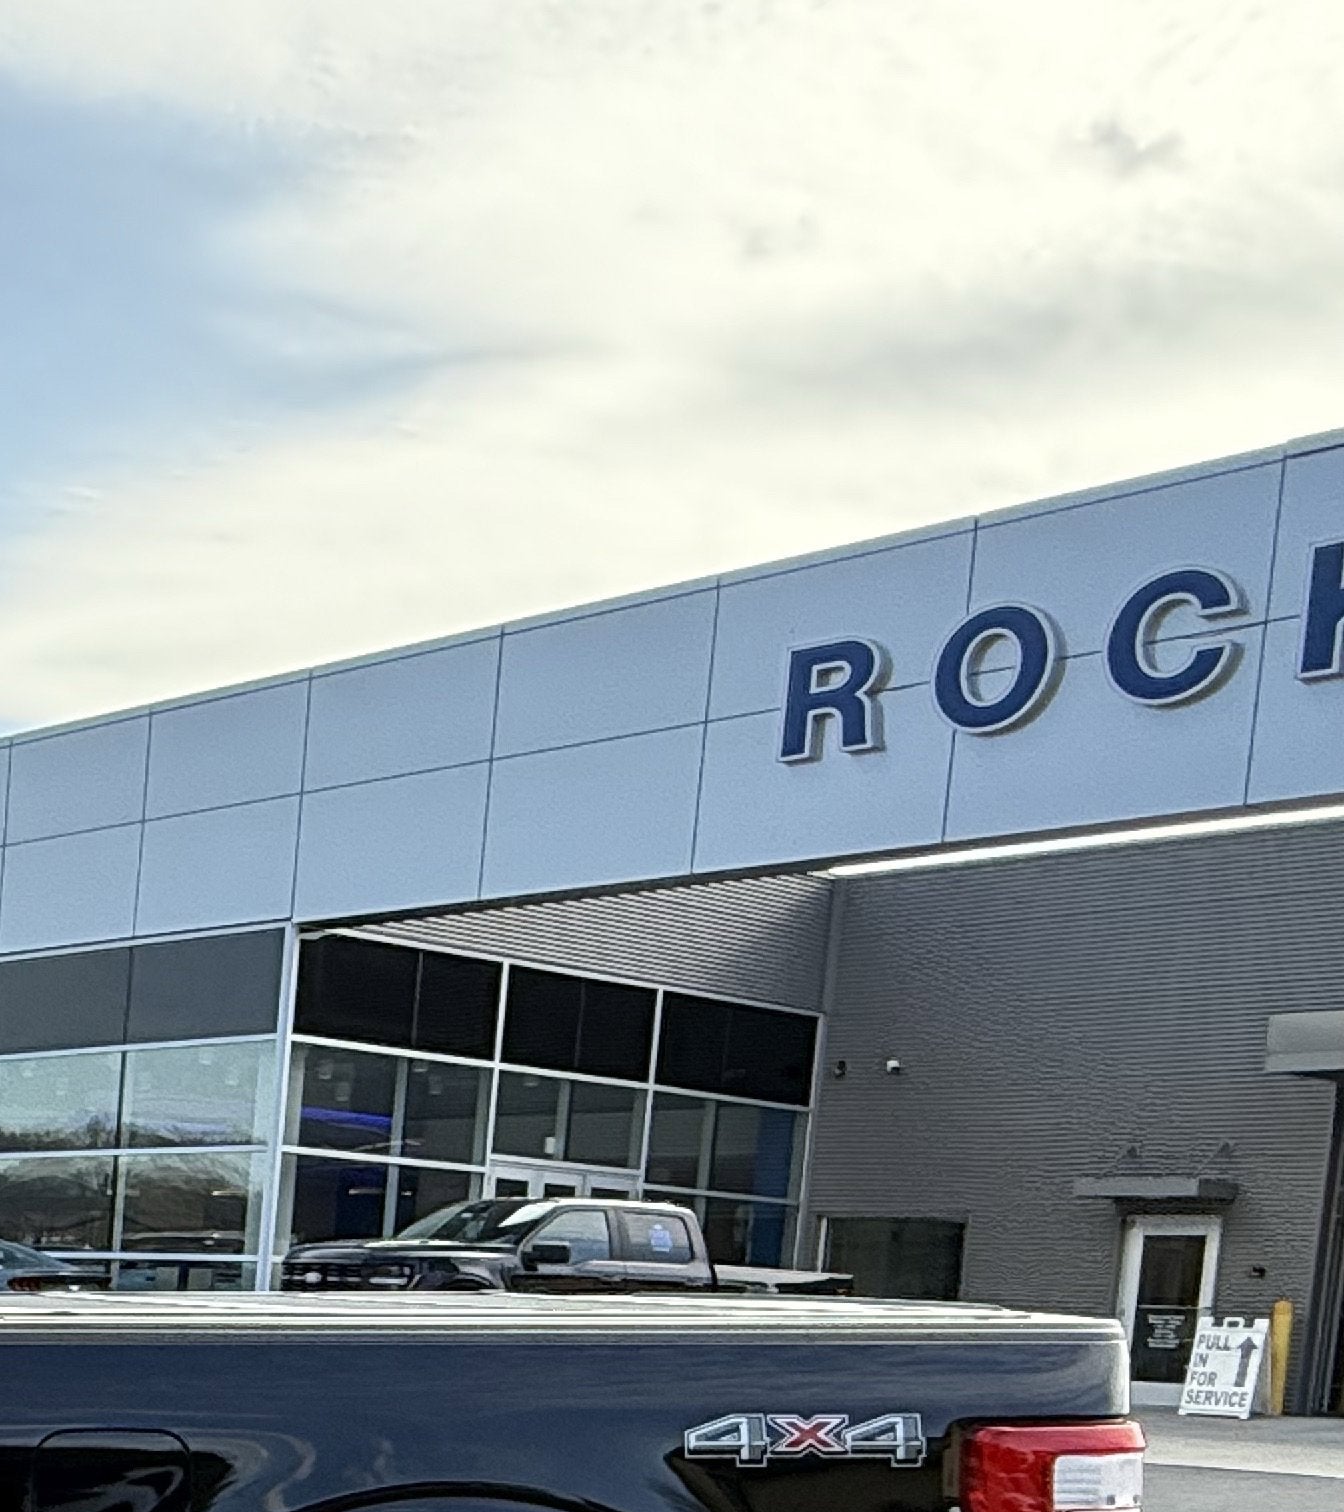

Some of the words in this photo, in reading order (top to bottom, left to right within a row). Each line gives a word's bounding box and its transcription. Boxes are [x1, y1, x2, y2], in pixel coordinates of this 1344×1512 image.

[1197, 1333, 1231, 1351] PULL
[1193, 1352, 1209, 1368] IN
[1190, 1370, 1218, 1387] FOR
[1184, 1388, 1250, 1408] SERVICE
